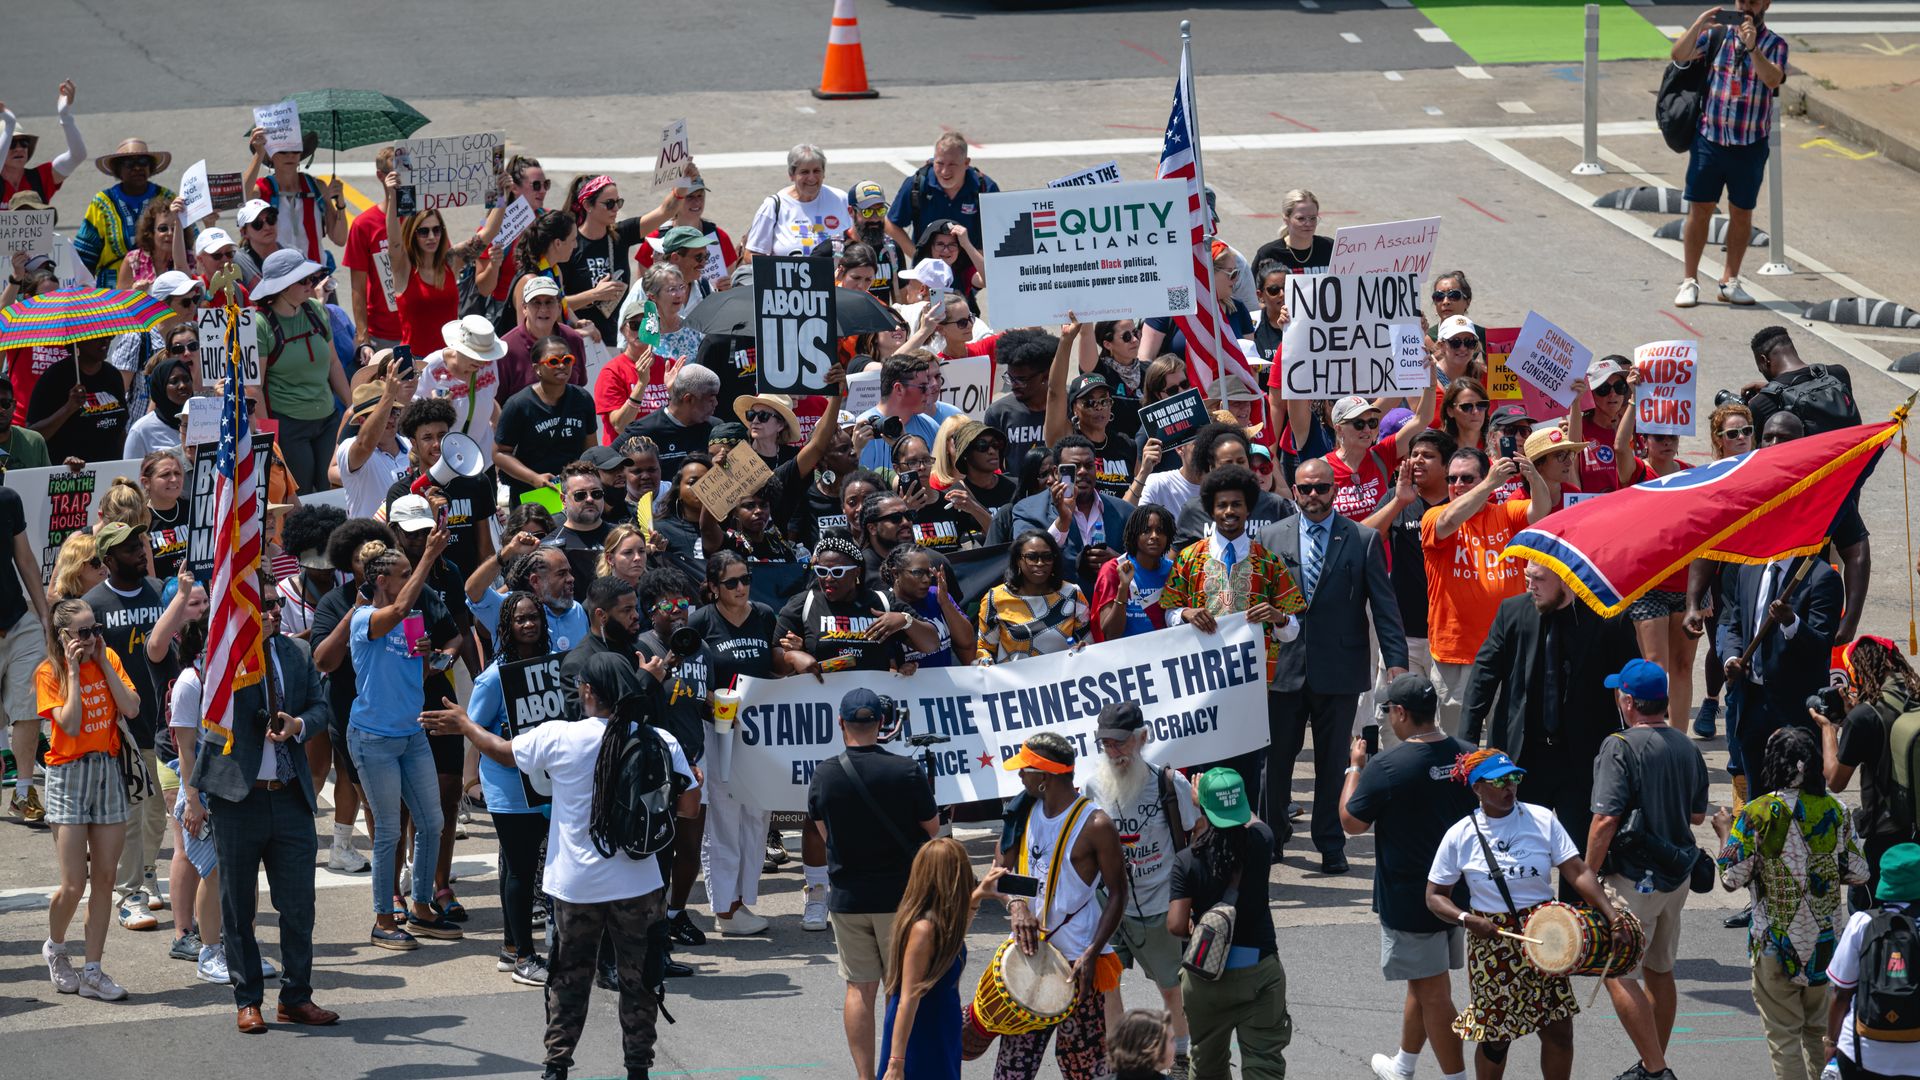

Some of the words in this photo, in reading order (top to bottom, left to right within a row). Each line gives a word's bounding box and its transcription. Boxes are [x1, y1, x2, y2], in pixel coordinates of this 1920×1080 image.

[407, 137, 459, 157] WHAT
[462, 132, 498, 150] GOOD
[660, 138, 688, 168] NOW
[410, 163, 488, 183] FREEDOM
[415, 155, 436, 169] IS
[1096, 165, 1118, 182] THE
[1032, 201, 1054, 211] THE
[0, 214, 19, 226] HIS
[25, 213, 51, 226] ONLY
[1032, 200, 1174, 239] EQUITY
[8, 240, 35, 252] HERE
[1036, 230, 1177, 255] ALLIANCE
[1336, 236, 1367, 257] Ban
[1375, 225, 1438, 250] Assault
[1020, 263, 1051, 277] Building
[1053, 259, 1099, 276] Independent
[1101, 259, 1122, 270] Black
[1123, 256, 1157, 270] political,
[1394, 251, 1431, 273] NOW
[775, 262, 812, 289] IT'S
[1019, 281, 1037, 292] civic
[1038, 279, 1053, 291] and
[1054, 277, 1090, 290] economic
[1091, 277, 1116, 289] power
[1117, 273, 1138, 285] since
[1139, 271, 1161, 282] 2016.
[762, 289, 829, 317] ABOUT
[1291, 275, 1342, 323] NO
[1356, 273, 1422, 322] MORE
[199, 308, 251, 329] ARS
[1309, 323, 1391, 353] DEAD
[1402, 335, 1421, 345] Kids
[1545, 329, 1575, 357] CHANGE
[201, 345, 258, 380] HUGNG
[762, 317, 832, 390] US
[1402, 347, 1418, 356] Not
[1536, 339, 1553, 357] GUN
[1552, 349, 1574, 370] LAWS
[1639, 345, 1690, 358] PROTECT
[1400, 359, 1423, 368] Guns
[1537, 355, 1569, 382] CHANGE
[1639, 359, 1694, 385] KIDS
[1287, 357, 1424, 395] CHILDR
[1493, 383, 1517, 391] KIDS,
[1521, 360, 1562, 392] CONGRESS
[1653, 386, 1676, 397] NOT
[1146, 413, 1153, 423] IF
[1153, 408, 1167, 420] YOU
[1166, 401, 1185, 416] DON'T
[1185, 396, 1197, 408] ACT
[1156, 416, 1170, 429] LIKE
[1170, 407, 1194, 424] ADULTS
[1640, 397, 1692, 426] GUNS
[1164, 426, 1175, 436] WE
[49, 480, 76, 494] FROM
[76, 478, 95, 490] THE
[699, 480, 710, 493] AT
[52, 492, 91, 514] TRAP
[50, 513, 87, 530] HOUSE
[1453, 568, 1479, 580] NOT
[1487, 567, 1518, 581] GUNS
[106, 606, 166, 629] MEMPHI
[716, 637, 768, 653] IMMIGRANTS
[732, 648, 760, 660] VOTE
[670, 679, 694, 705] for
[741, 702, 834, 746] STAND
[919, 695, 978, 736] THE
[982, 664, 1158, 733] TENNESSEE
[1162, 640, 1259, 699] THREE
[87, 705, 108, 719] NOT
[84, 718, 112, 733] GUNS
